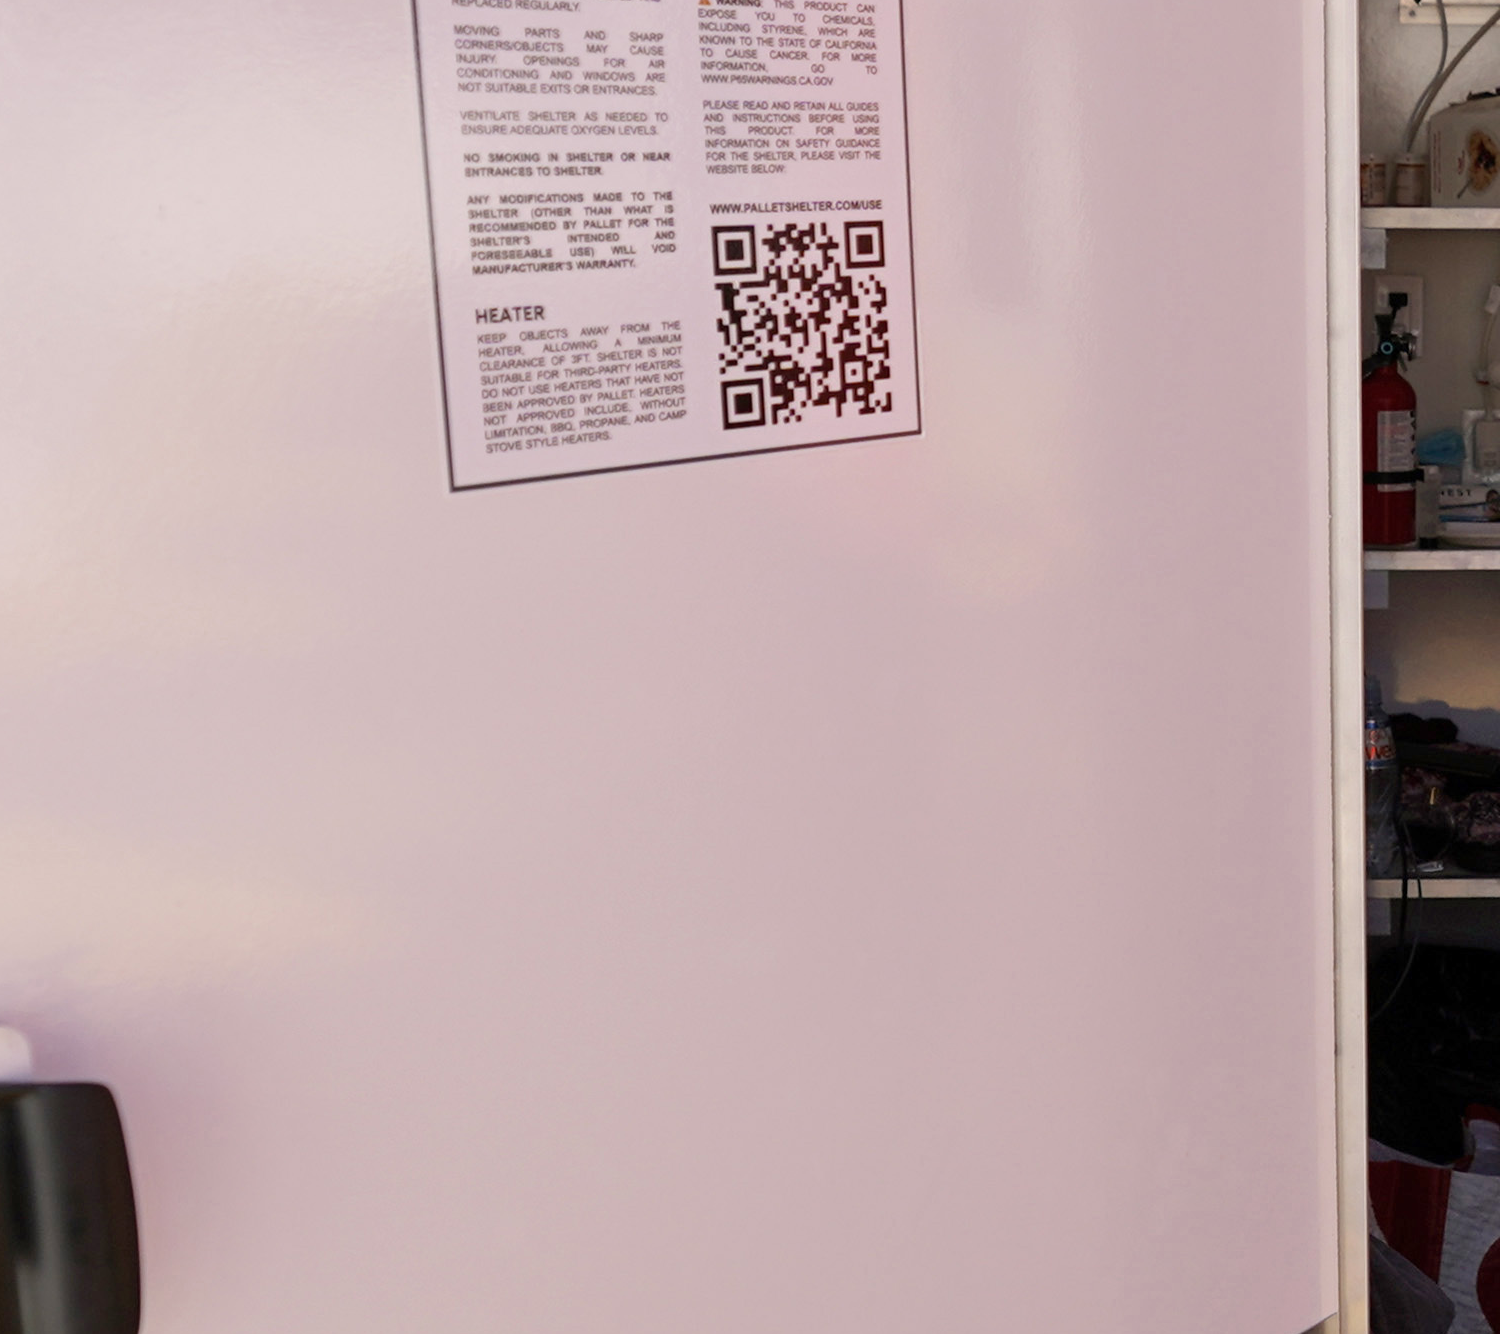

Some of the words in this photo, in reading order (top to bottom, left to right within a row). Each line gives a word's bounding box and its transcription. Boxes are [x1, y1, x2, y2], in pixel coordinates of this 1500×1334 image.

[701, 99, 740, 110] PLEASE
[741, 100, 769, 110] READ
[770, 100, 792, 110] AND
[792, 100, 826, 111] RETAIN
[827, 101, 843, 111] ALL
[845, 101, 880, 111] GUIDES
[702, 112, 725, 122] AND
[731, 112, 802, 123] INSTRUCTIONS
[807, 113, 845, 123] BEFORE
[851, 114, 880, 123] USING
[704, 125, 727, 135] THIS
[814, 126, 835, 135] FOR
[853, 126, 880, 135] MORE
[704, 138, 771, 148] INFORMATION
[774, 138, 790, 148] ON
[794, 138, 830, 148] SAFETY
[834, 138, 881, 148] GUIDANCE
[462, 152, 481, 163] NO
[487, 152, 541, 163] SMOKING
[546, 152, 560, 162] IN
[565, 151, 615, 162] SHELTER
[619, 151, 637, 162] OR
[641, 151, 672, 162] NEAR
[704, 151, 727, 161] FOR
[730, 151, 749, 161] THE
[799, 150, 836, 160] PLEASE
[838, 150, 861, 160] VISIT
[864, 150, 882, 160] THE
[463, 166, 534, 177] ENTRANCES
[536, 165, 552, 176] TO
[705, 163, 749, 174] WEBSITE
[466, 194, 491, 205] ANY
[498, 192, 585, 205] MODIFICATIONS
[591, 191, 624, 202] MADE
[631, 191, 646, 201] TO
[652, 190, 674, 201] THE
[466, 207, 520, 219] SHELTER
[583, 205, 613, 216] THAN
[622, 204, 654, 215] WHAT
[663, 203, 675, 214] IS
[708, 199, 883, 215] WWW.PALLETSHELTER.COM/USE
[468, 220, 558, 233] RECOMMENDED
[561, 219, 578, 230] BY
[582, 218, 623, 229] PALLET
[626, 217, 650, 228] FOR
[654, 216, 676, 227] THE
[565, 231, 621, 243] INTENDED
[654, 229, 676, 240] AND
[469, 247, 553, 261] FORESEEABLE
[568, 245, 596, 258] USE)
[610, 244, 636, 255] WILL
[651, 242, 677, 253] VOID
[474, 304, 546, 326] HEATER
[476, 331, 508, 344] KEEP
[518, 327, 569, 341] OBJECTS
[579, 324, 610, 336] AWAY
[619, 321, 652, 333] FROM
[661, 319, 681, 330] THE
[541, 338, 599, 353] ALLOWING
[613, 336, 623, 347] A
[636, 332, 683, 345] MINIMUM
[478, 355, 547, 371] CLEARANCE
[549, 354, 567, 365] OF
[595, 347, 644, 361] SHELTER
[646, 346, 658, 357] IS
[661, 344, 683, 356] NOT
[479, 370, 533, 385] SUITABLE
[535, 367, 560, 380] FOR
[563, 361, 632, 377] THIRD-PARTY
[480, 386, 500, 399] DO
[500, 384, 526, 397] NOT
[527, 382, 551, 394] USE
[552, 377, 603, 392] HEATERS
[605, 374, 631, 387] THAT
[633, 372, 661, 384] HAVE
[662, 370, 685, 382] NOT
[481, 399, 514, 412] BEEN
[516, 393, 577, 409] APPROVED
[578, 391, 594, 403] BY
[638, 382, 686, 397] HEATERS
[482, 413, 508, 426] NOT
[515, 406, 576, 422] APPROVED
[639, 395, 686, 410] WITHOUT
[633, 411, 657, 423] AND
[657, 407, 688, 420] CAMP
[484, 438, 523, 453] STOVE
[524, 434, 560, 448] STYLE
